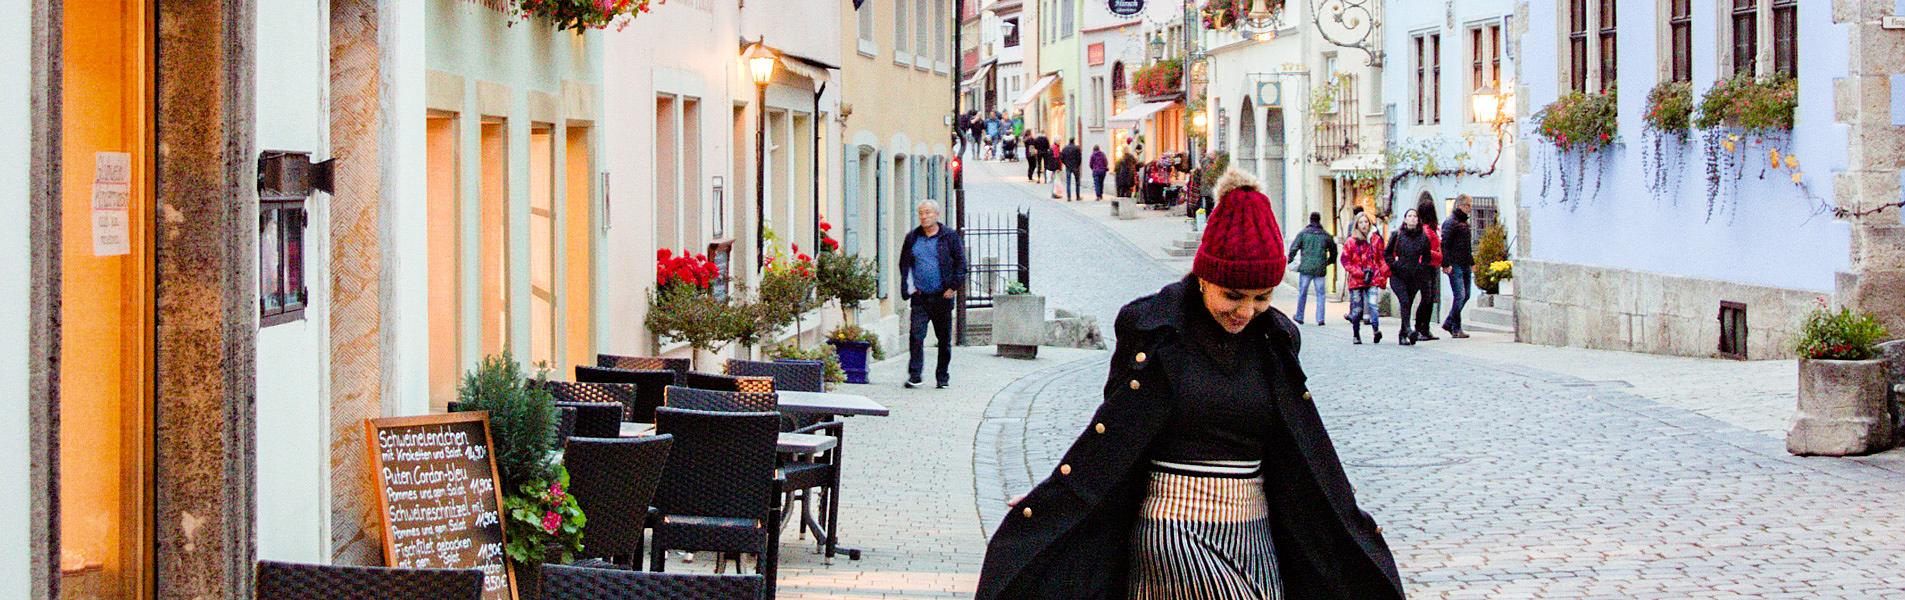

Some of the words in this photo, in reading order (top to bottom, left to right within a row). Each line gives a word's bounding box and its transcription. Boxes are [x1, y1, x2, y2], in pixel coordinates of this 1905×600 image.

[379, 425, 469, 448] Schweinelendchen
[382, 449, 395, 461] mit
[396, 448, 432, 461] Kroketten
[432, 448, 444, 460] und
[445, 446, 463, 458] Salat
[383, 466, 413, 485] Puten
[413, 462, 468, 485] Cordon-bleu
[385, 486, 418, 502] Pommes
[420, 487, 433, 500] und
[446, 482, 466, 496] Salat
[470, 477, 493, 496] 11,90€
[390, 496, 471, 522] Schweineschnitzel
[472, 498, 485, 513] mit
[391, 525, 421, 540] Pommes
[421, 524, 434, 536] und
[448, 518, 467, 531] Salat
[475, 511, 499, 528] 11,90€
[394, 537, 435, 558] Fischfilet
[436, 537, 472, 558] gebacken
[443, 551, 461, 564] Salat
[477, 542, 503, 560] 11,90€
